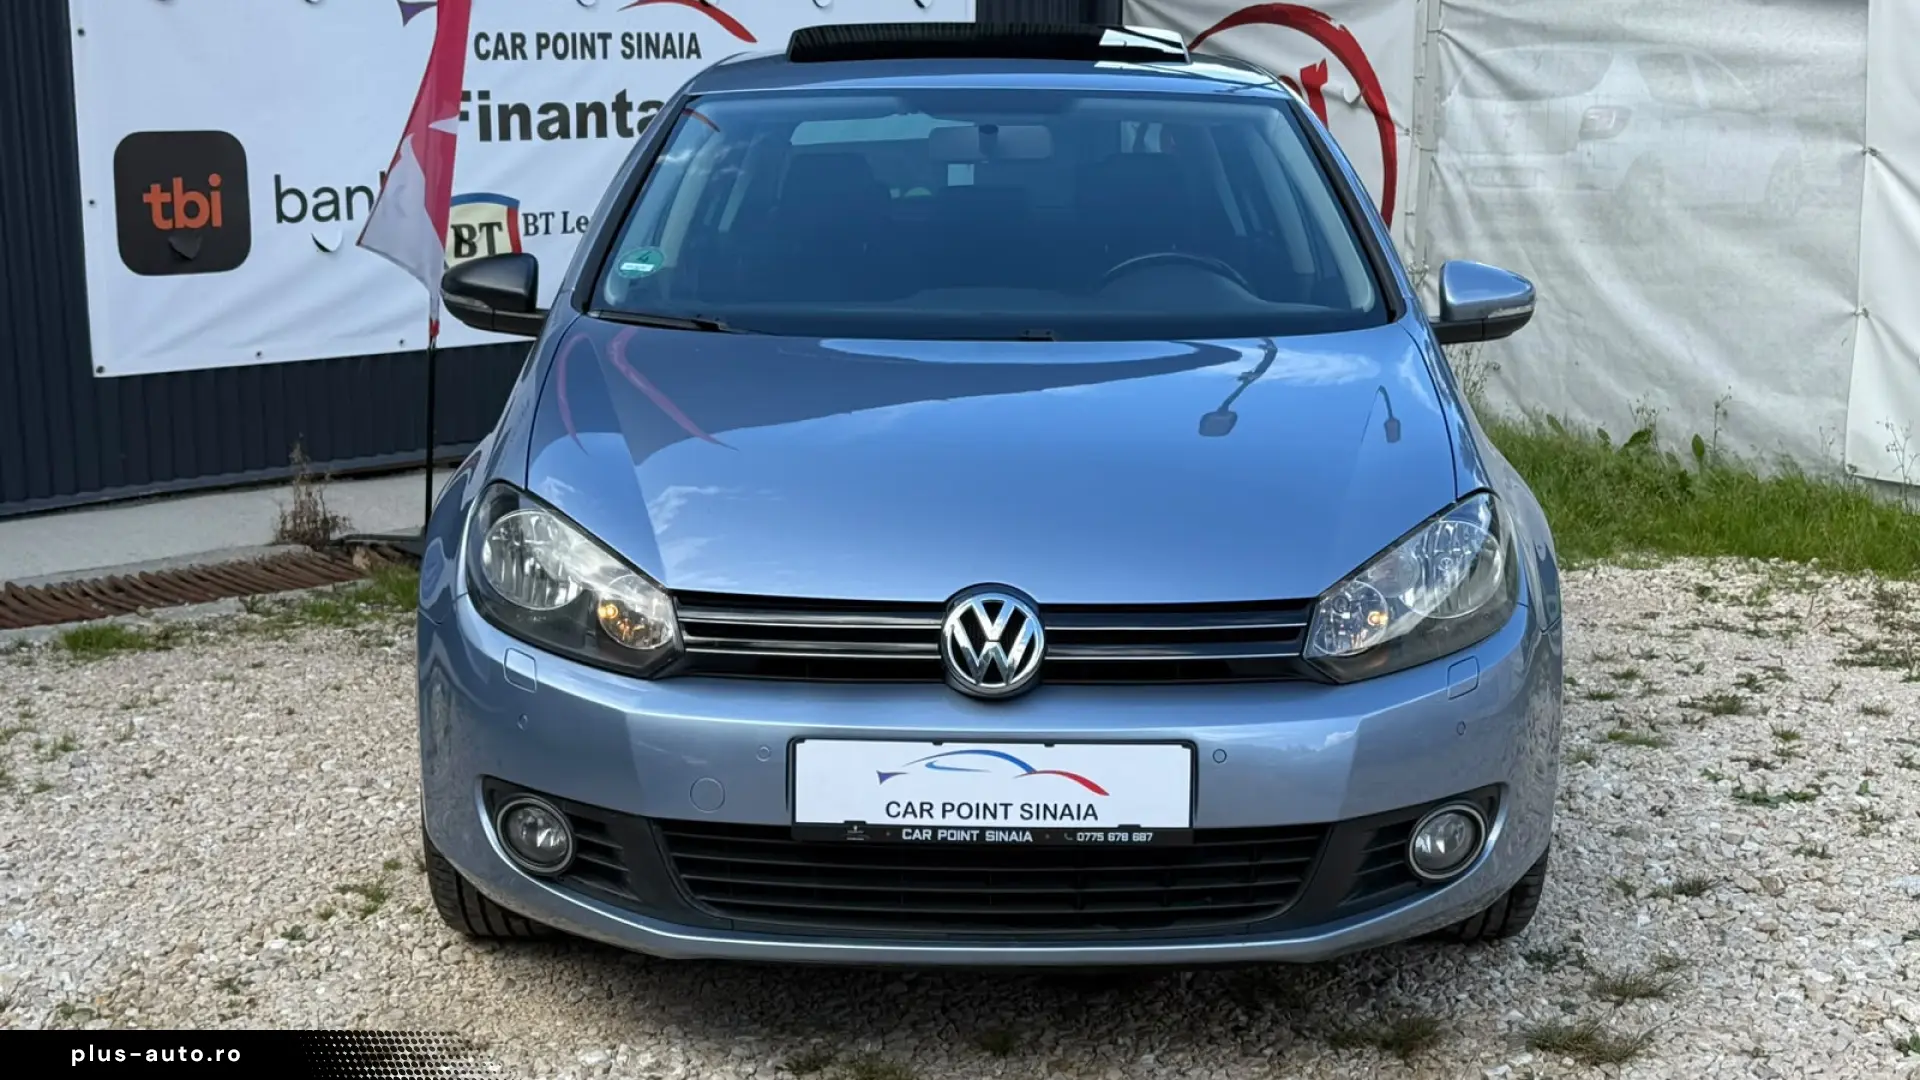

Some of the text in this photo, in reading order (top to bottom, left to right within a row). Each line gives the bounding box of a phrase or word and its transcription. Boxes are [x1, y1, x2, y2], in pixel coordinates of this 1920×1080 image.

[474, 32, 702, 60] CAR POINT SINAIA
[142, 170, 386, 230] tbi ban
[521, 212, 555, 237] BT
[450, 221, 504, 258] BT
[946, 594, 1042, 690] VW
[885, 801, 1098, 821] CAR POINT SINAIA
[901, 828, 932, 840] CAR
[937, 829, 980, 841] POINT
[985, 830, 1033, 842] SINAIA
[1076, 832, 1104, 842] 0775
